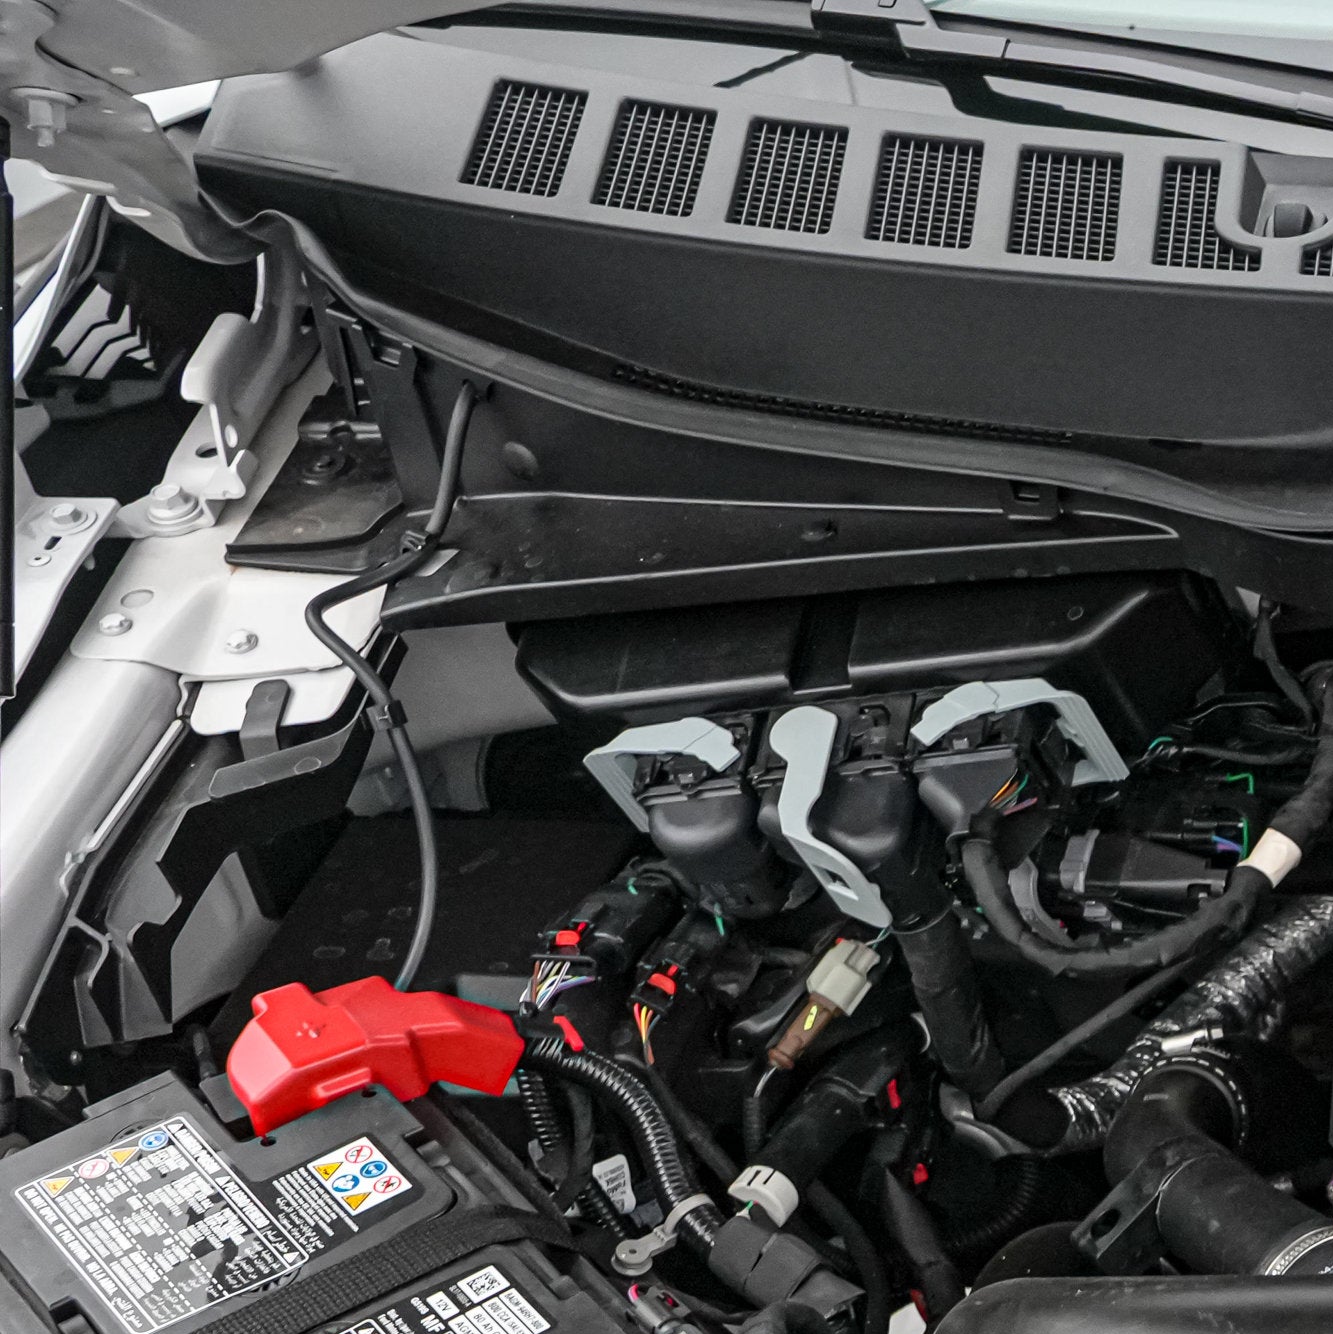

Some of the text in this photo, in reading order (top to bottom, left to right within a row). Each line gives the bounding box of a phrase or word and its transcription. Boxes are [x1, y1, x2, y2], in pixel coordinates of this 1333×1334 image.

[435, 1298, 451, 1312] 12V
[420, 1313, 446, 1333] MF
[473, 1313, 486, 1323] 80
[481, 1322, 495, 1332] Ah
